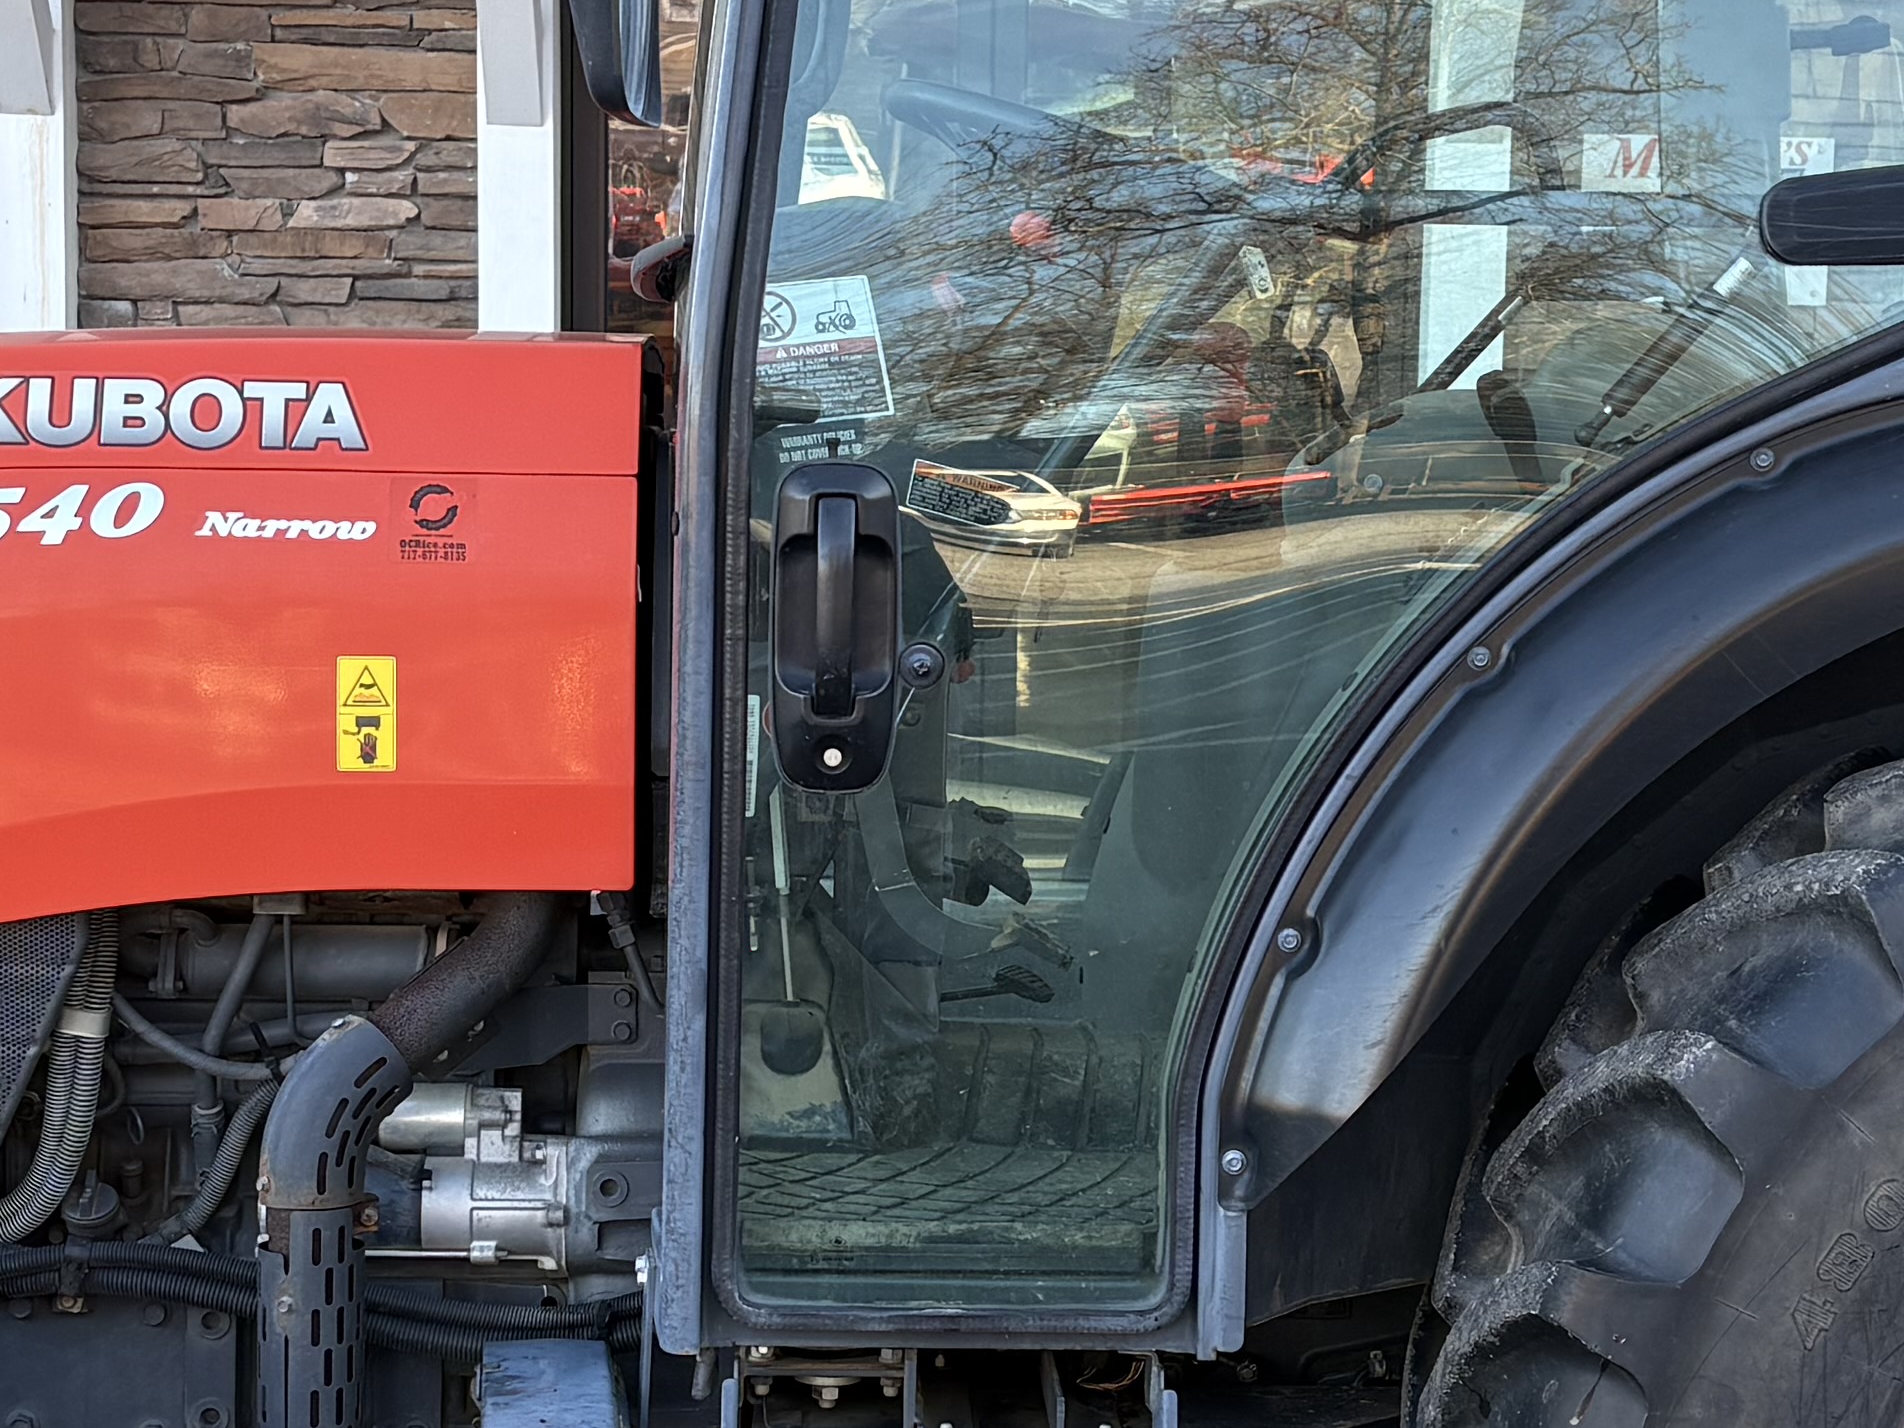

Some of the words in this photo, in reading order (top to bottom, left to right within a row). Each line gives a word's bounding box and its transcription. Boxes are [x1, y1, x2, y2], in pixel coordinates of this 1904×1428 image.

[790, 342, 839, 358] DANGER
[194, 509, 377, 542] Narrow
[399, 539, 466, 550] OCRice.com
